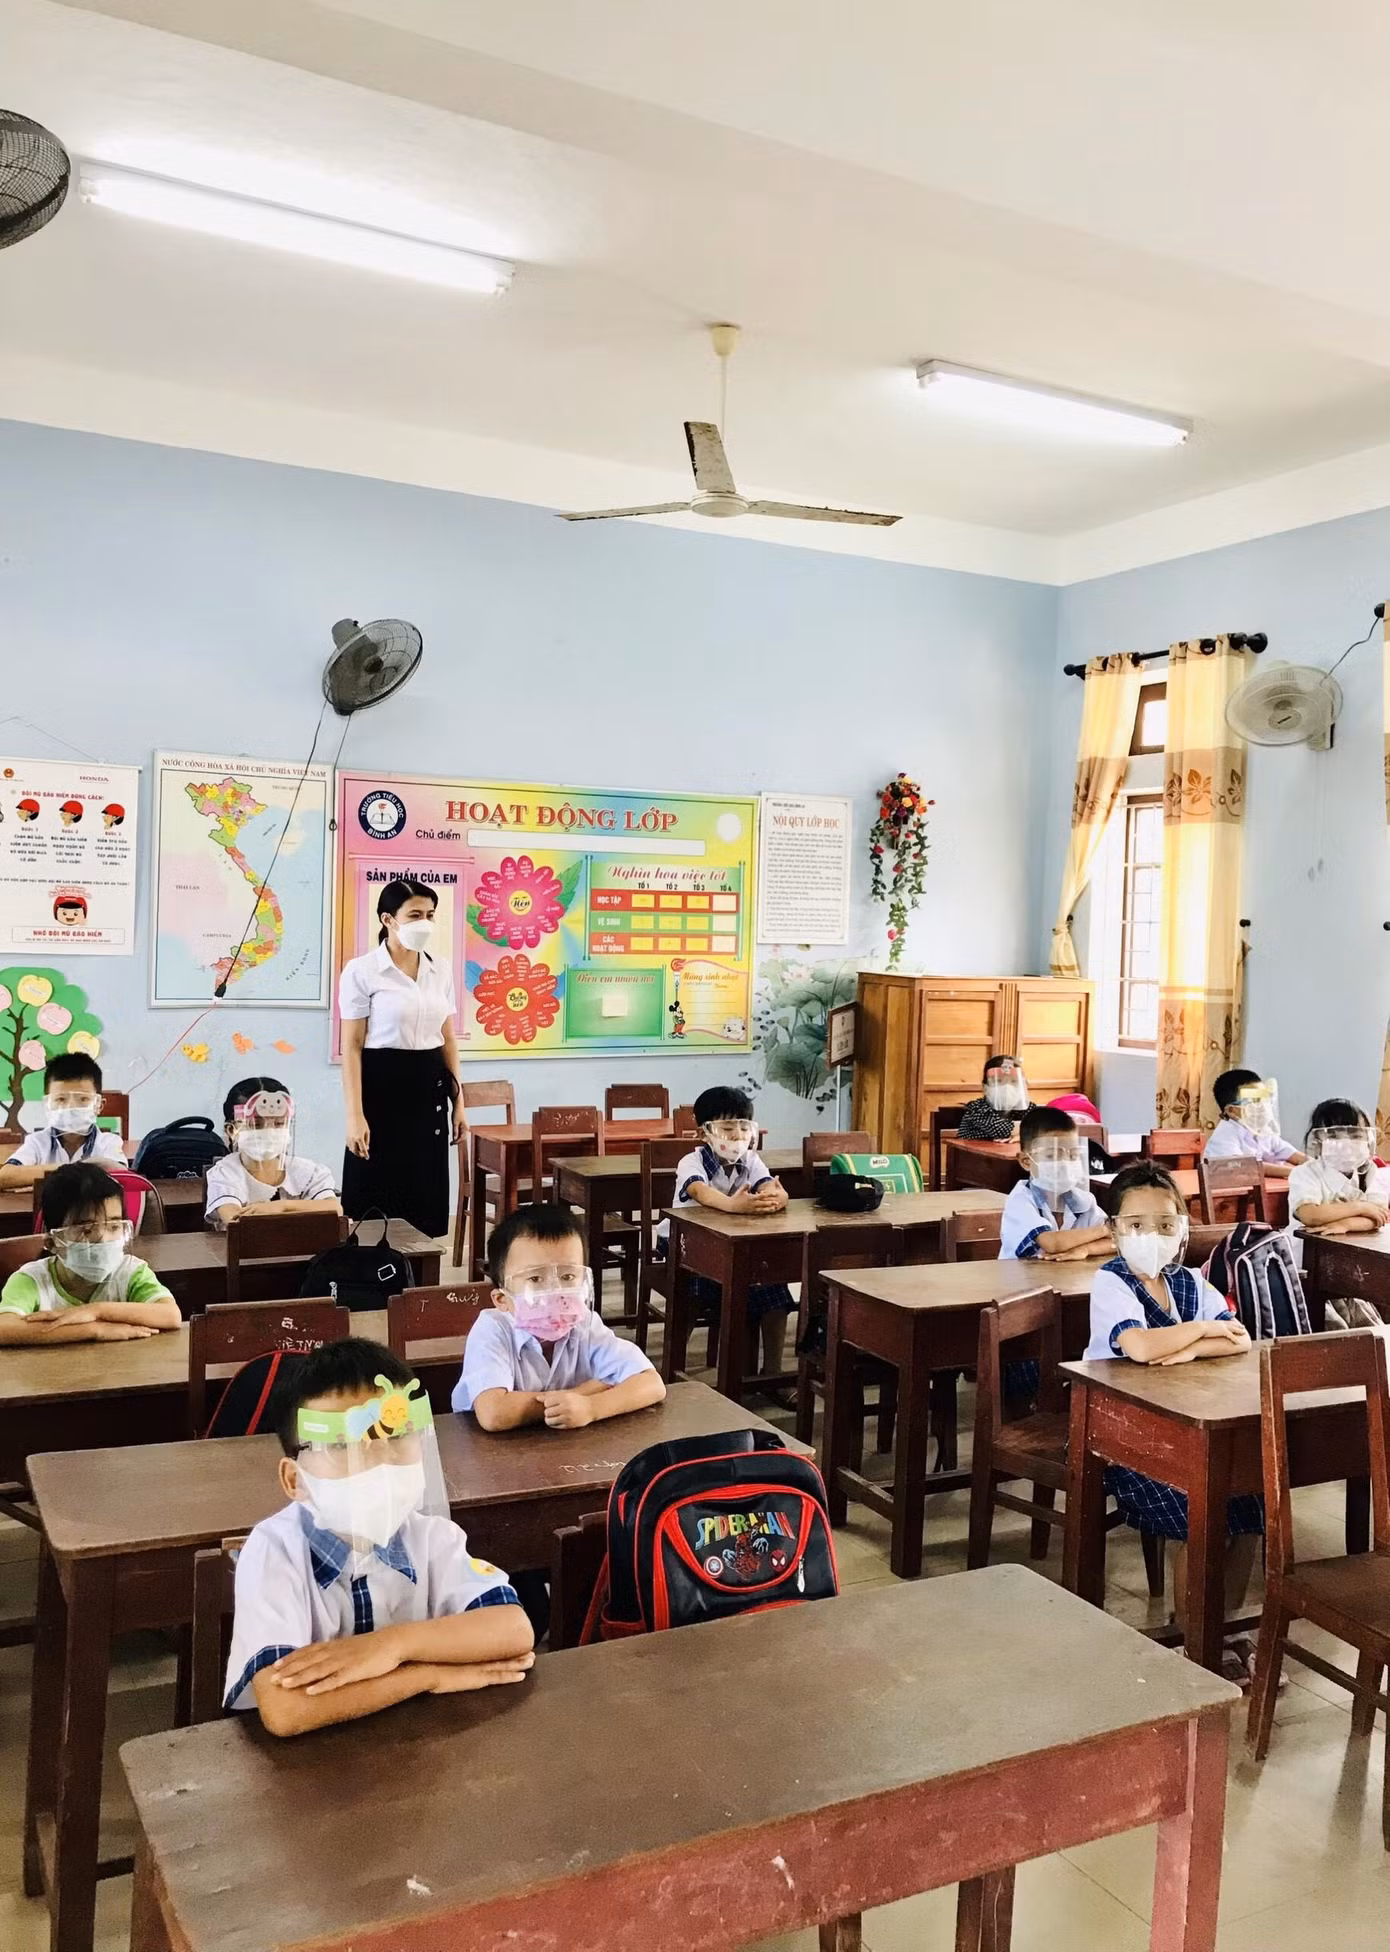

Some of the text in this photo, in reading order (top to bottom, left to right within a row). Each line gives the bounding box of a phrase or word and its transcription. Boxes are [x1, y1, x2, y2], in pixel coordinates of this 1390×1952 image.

[445, 801, 679, 832] HOẠT ĐỘNG LỚP
[387, 829, 397, 838] AN
[415, 828, 461, 841] Chủ điểm
[366, 868, 387, 881] SẢN
[420, 869, 441, 883] CỦA
[443, 873, 458, 884] EM
